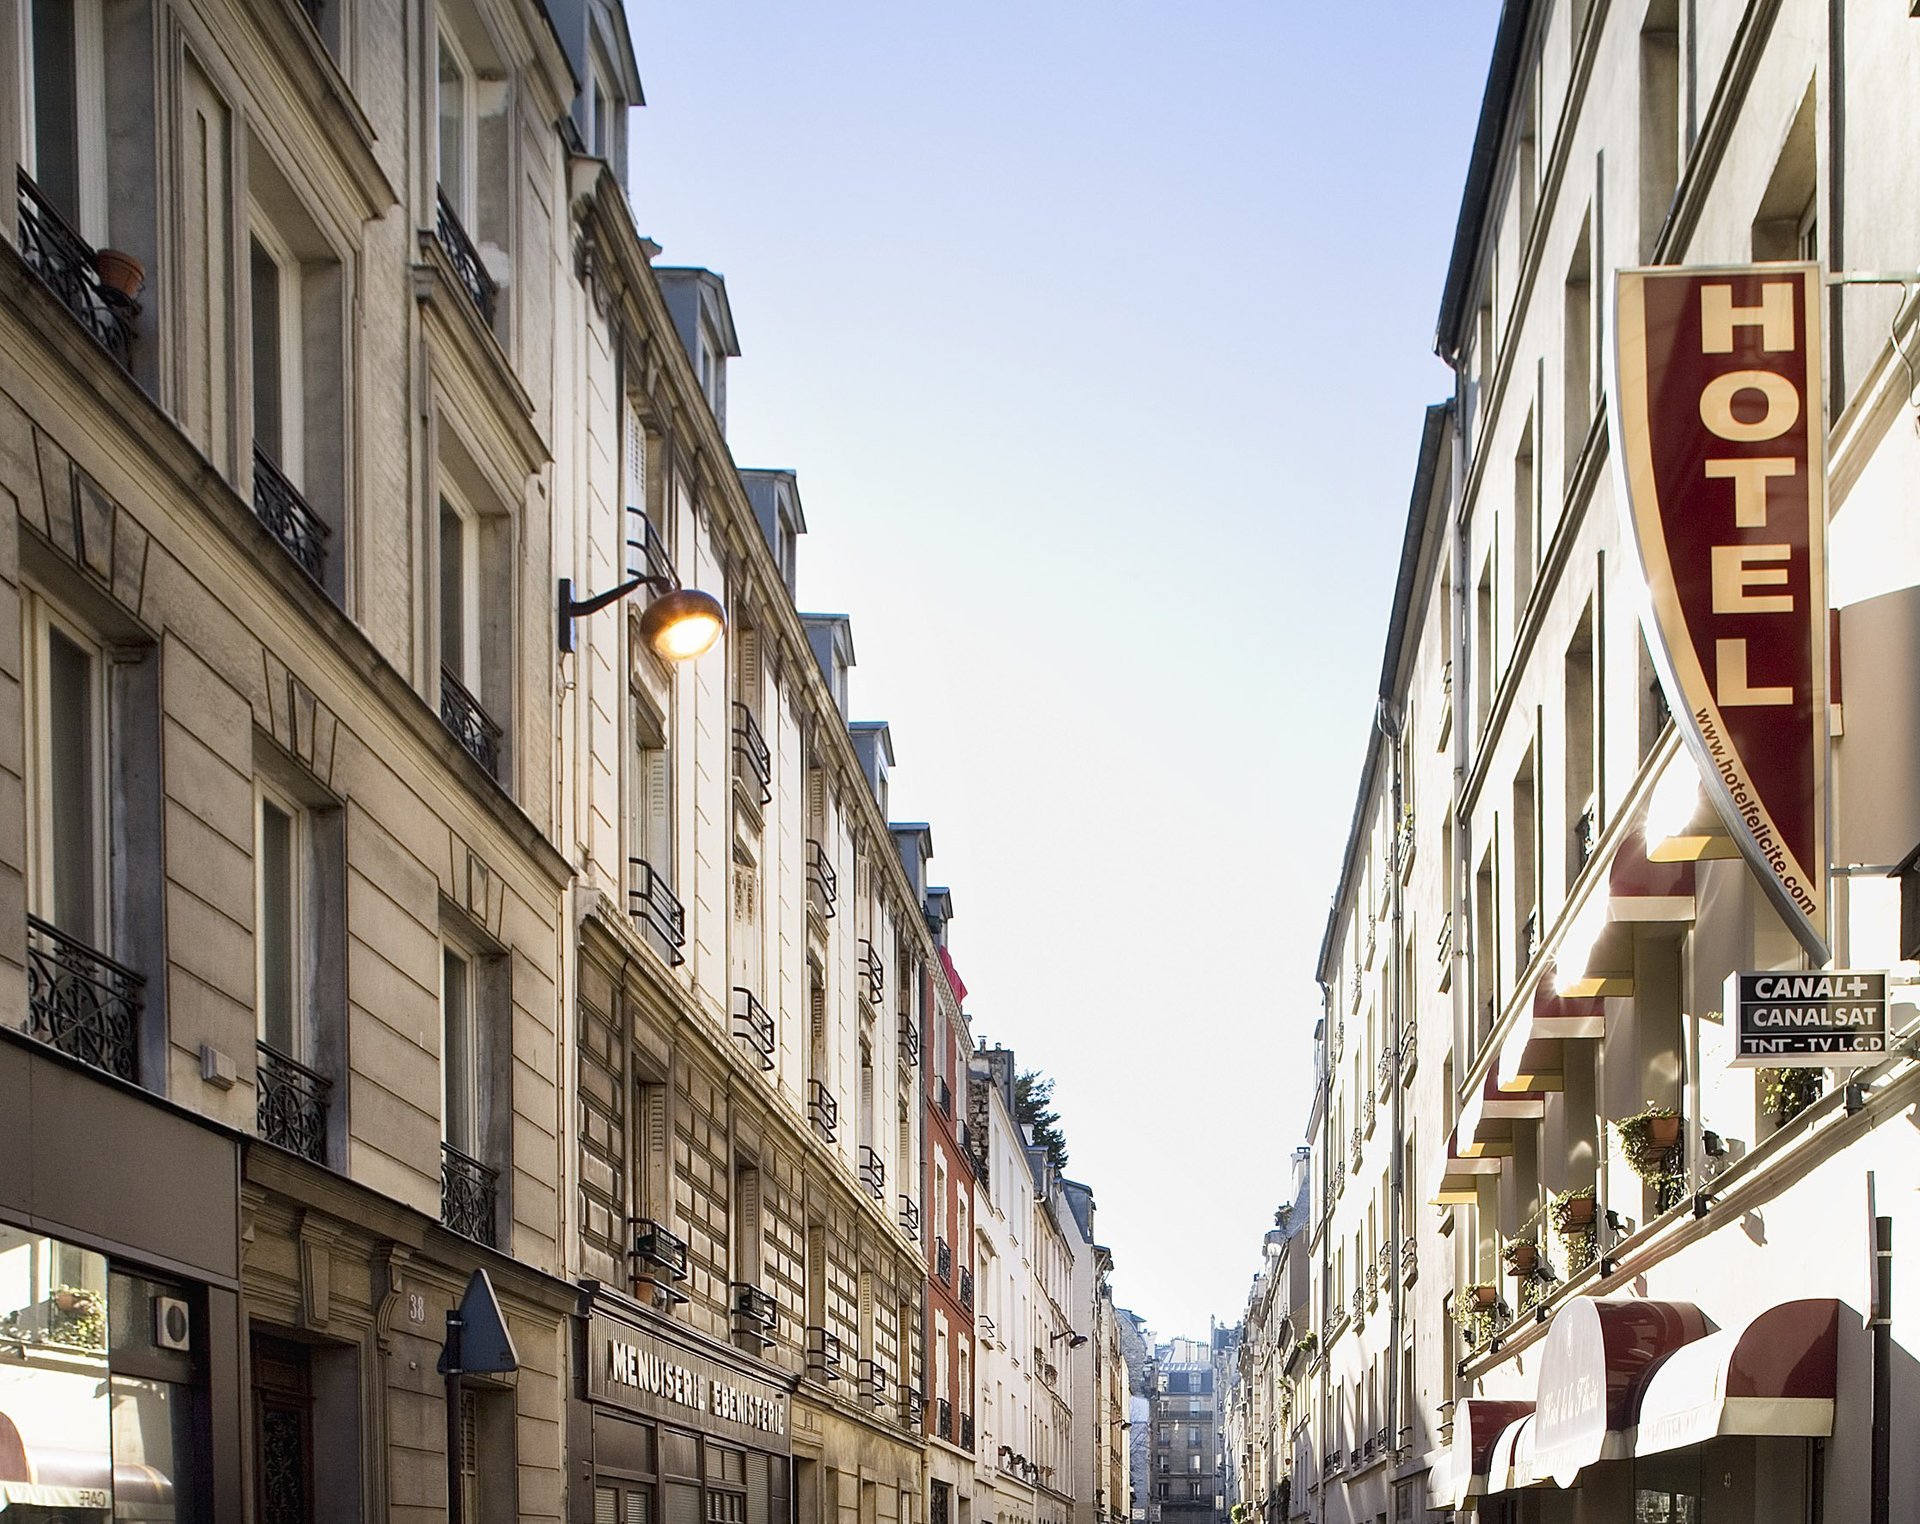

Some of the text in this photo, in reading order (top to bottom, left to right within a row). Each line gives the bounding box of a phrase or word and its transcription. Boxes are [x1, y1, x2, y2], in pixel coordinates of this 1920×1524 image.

[1700, 282, 1799, 707] HOTEL
[1695, 707, 1817, 916] www.hotelfelicite.com
[1755, 976, 1868, 999] CANAL+
[1743, 1039, 1792, 1053] TNT
[1807, 1038, 1832, 1052] TV
[410, 1294, 425, 1321] 38
[611, 1339, 784, 1435] MENUISERIE EBENISTERIE
